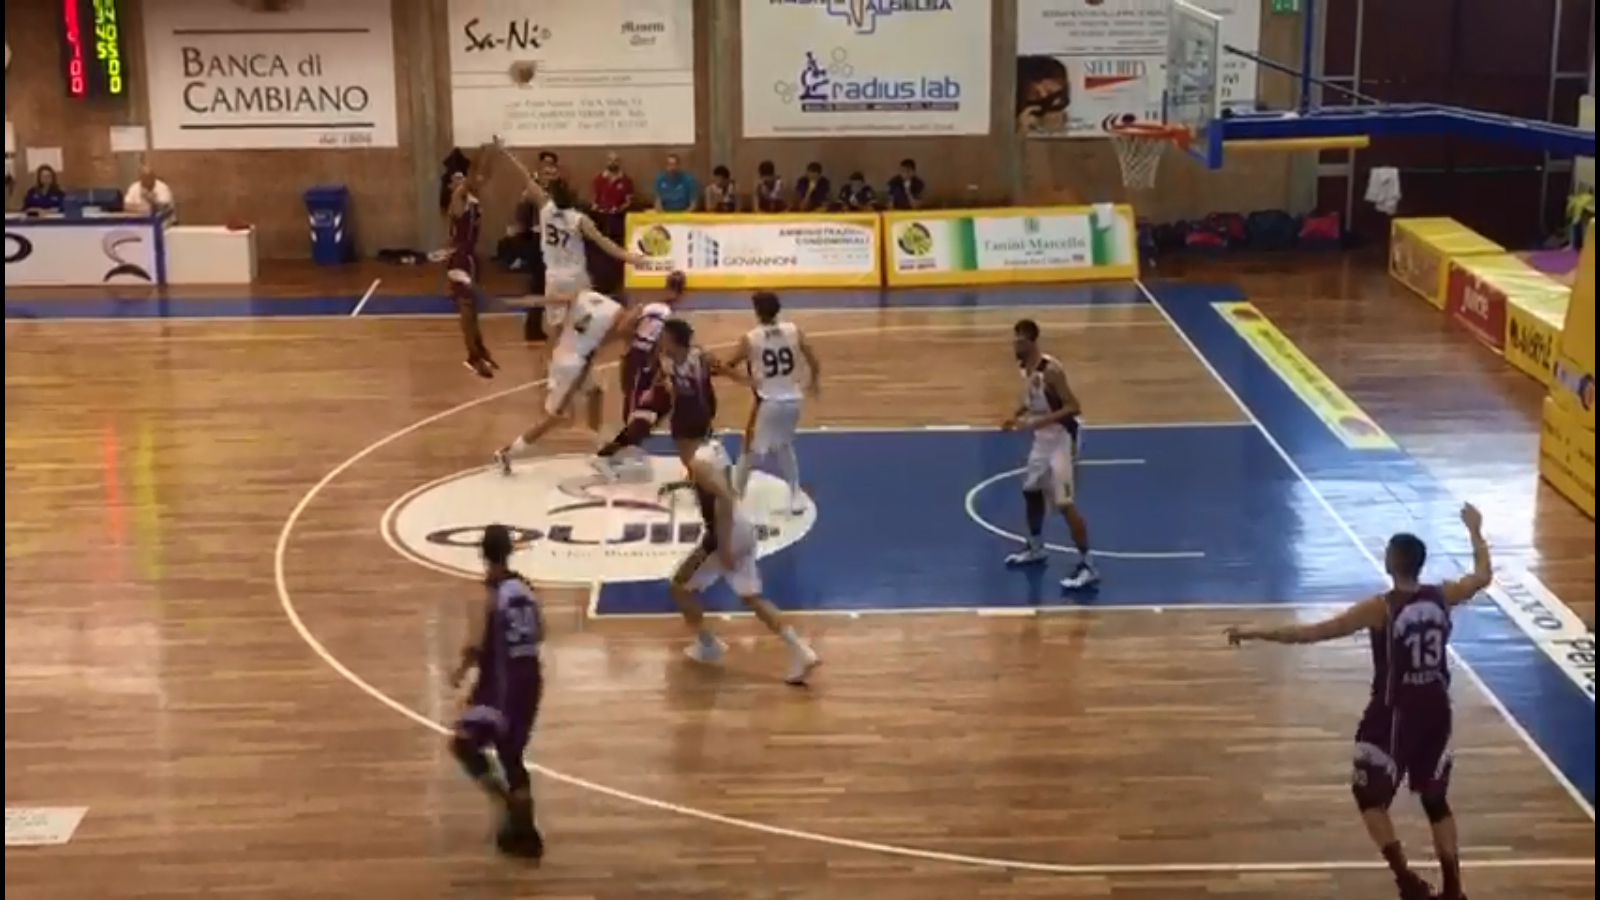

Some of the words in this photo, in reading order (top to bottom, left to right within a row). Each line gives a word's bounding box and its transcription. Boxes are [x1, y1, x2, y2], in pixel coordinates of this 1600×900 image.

[181, 46, 289, 78] BANCA
[297, 54, 323, 78] di
[183, 81, 369, 113] CAMBIANO
[832, 77, 915, 100] radius
[920, 76, 960, 99] lab
[545, 223, 571, 248] 37
[762, 346, 795, 378] 99
[1404, 627, 1442, 670] 13
